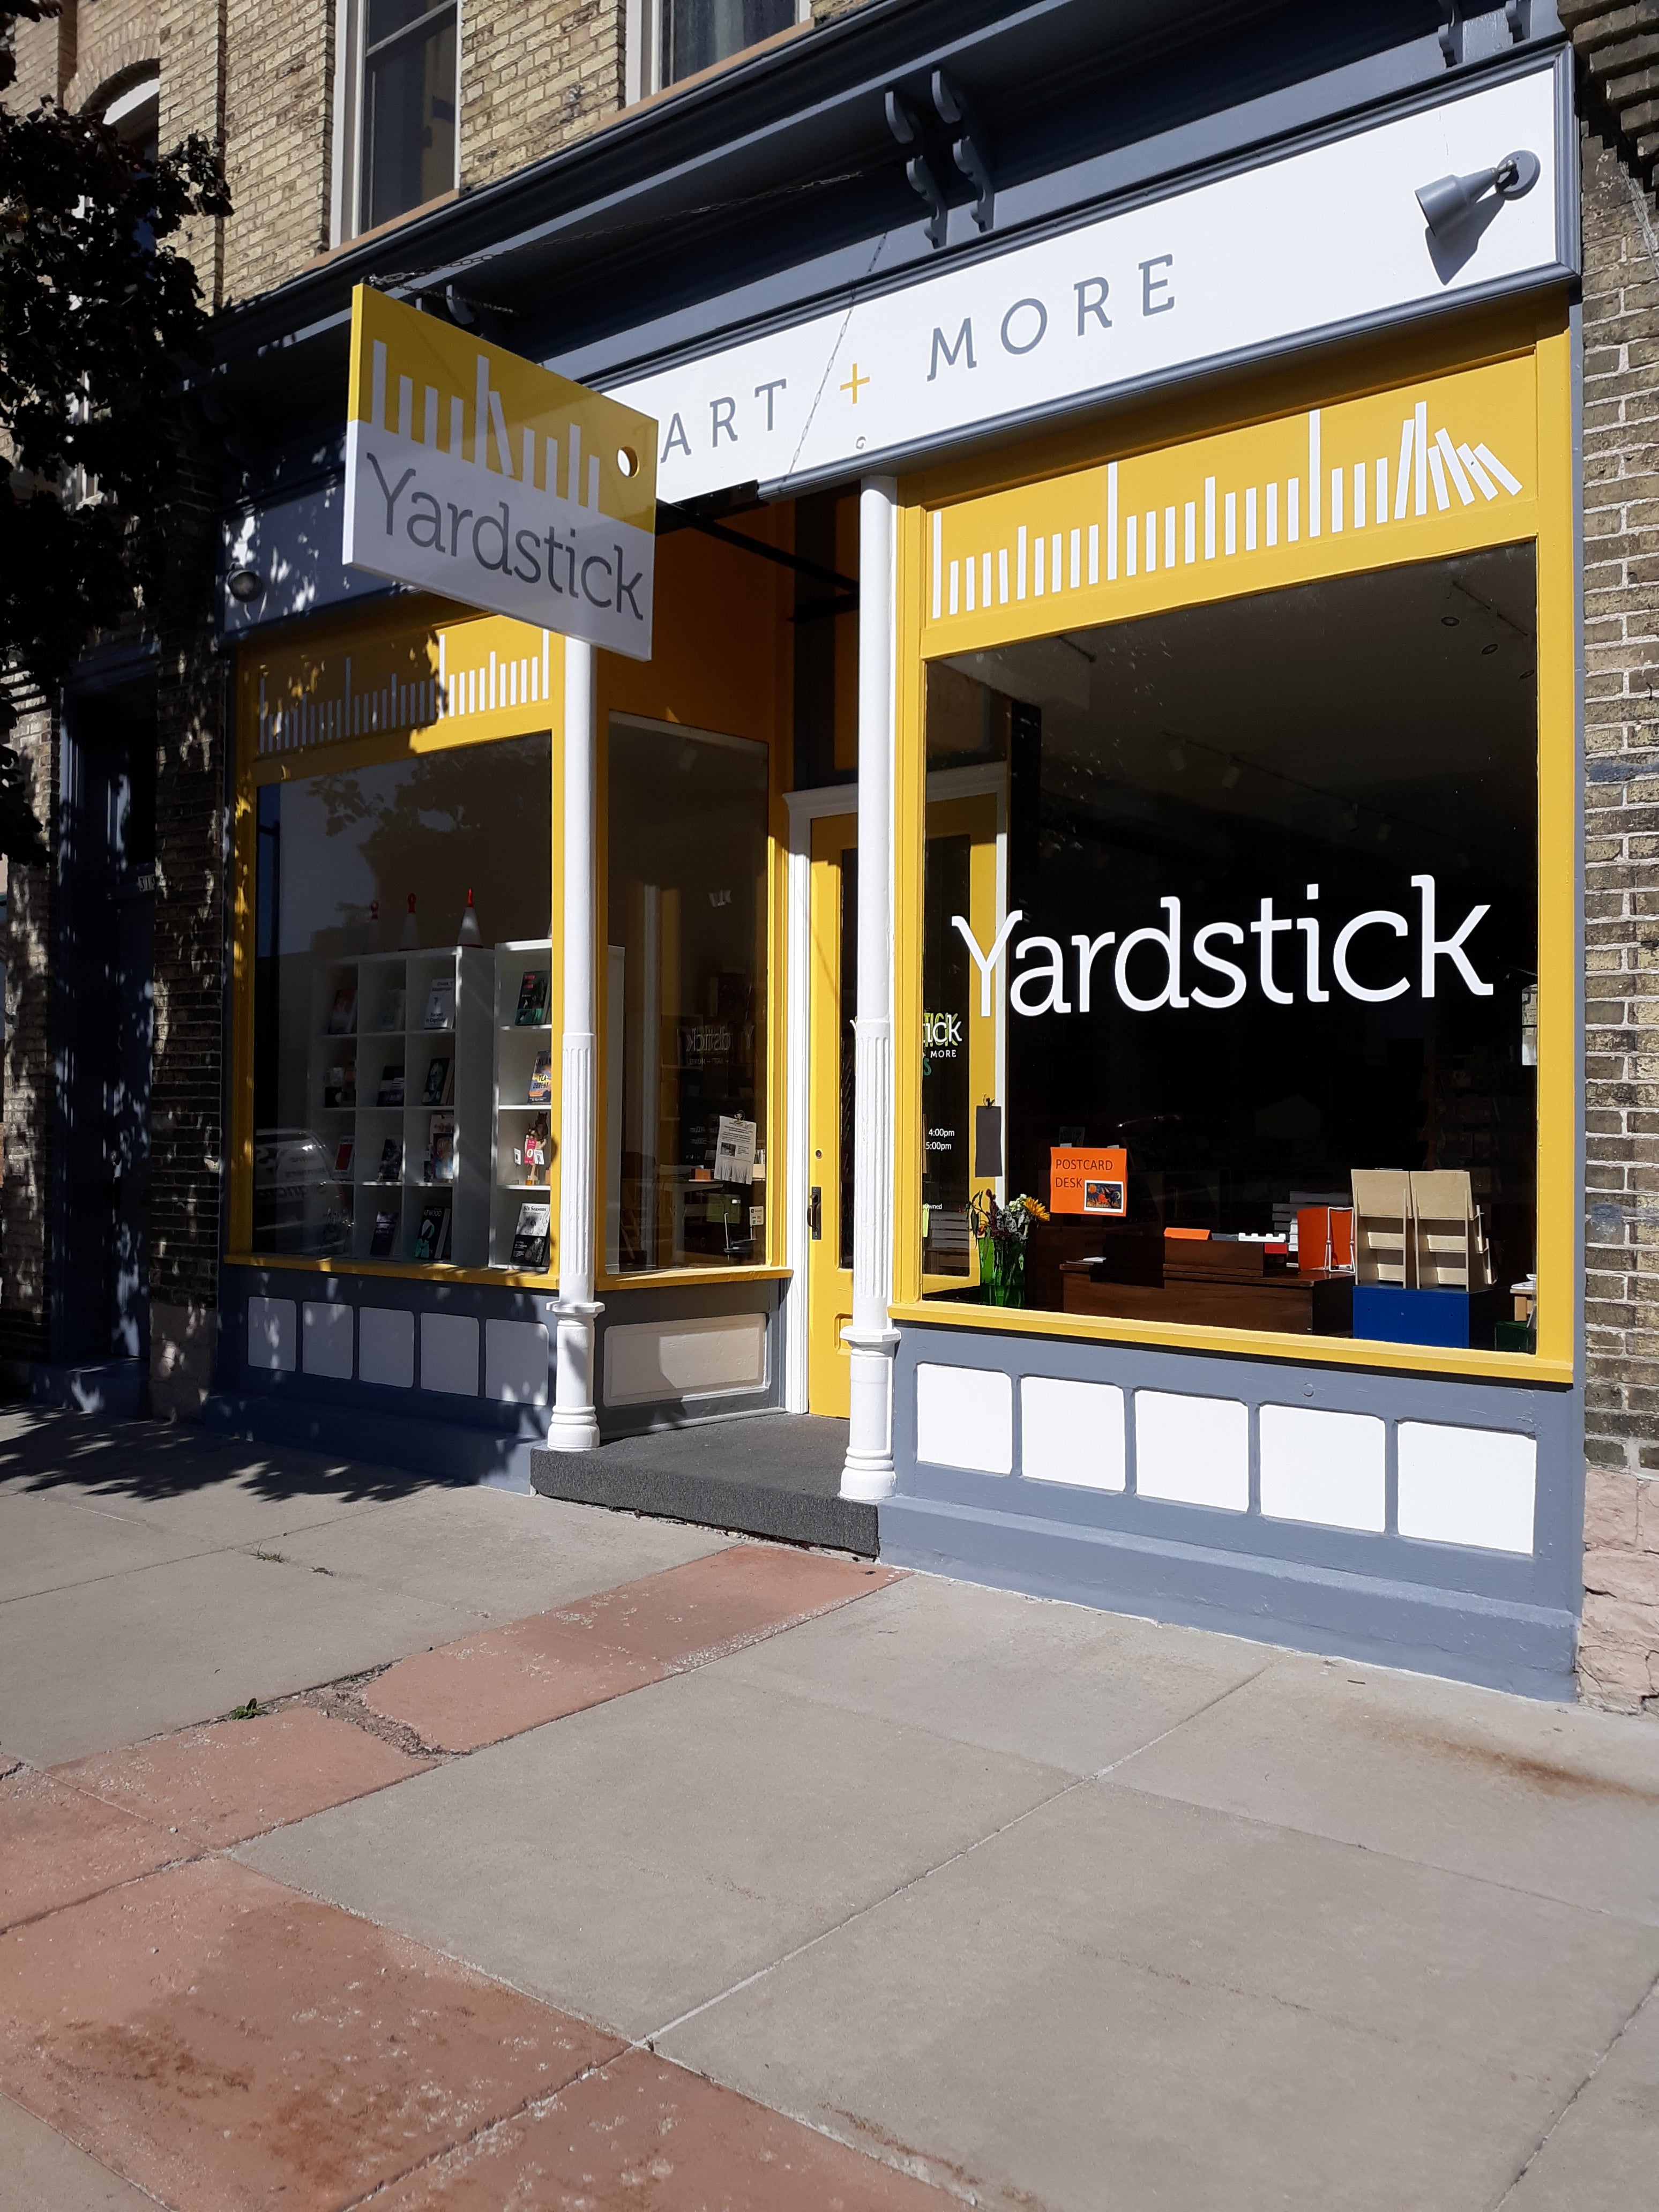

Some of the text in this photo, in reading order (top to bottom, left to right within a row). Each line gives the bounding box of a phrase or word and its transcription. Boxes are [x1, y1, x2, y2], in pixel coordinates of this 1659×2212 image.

[661, 378, 787, 464] ART
[926, 253, 1176, 382] MORE
[367, 452, 644, 621] Yardstick
[952, 875, 1493, 1017] Yardstick
[930, 1049, 957, 1058] MORE
[928, 1128, 955, 1138] 4:00pm
[925, 1141, 952, 1152] 5:00pm
[1056, 1159, 1114, 1171] POSTCARD
[1055, 1177, 1083, 1189] DESK
